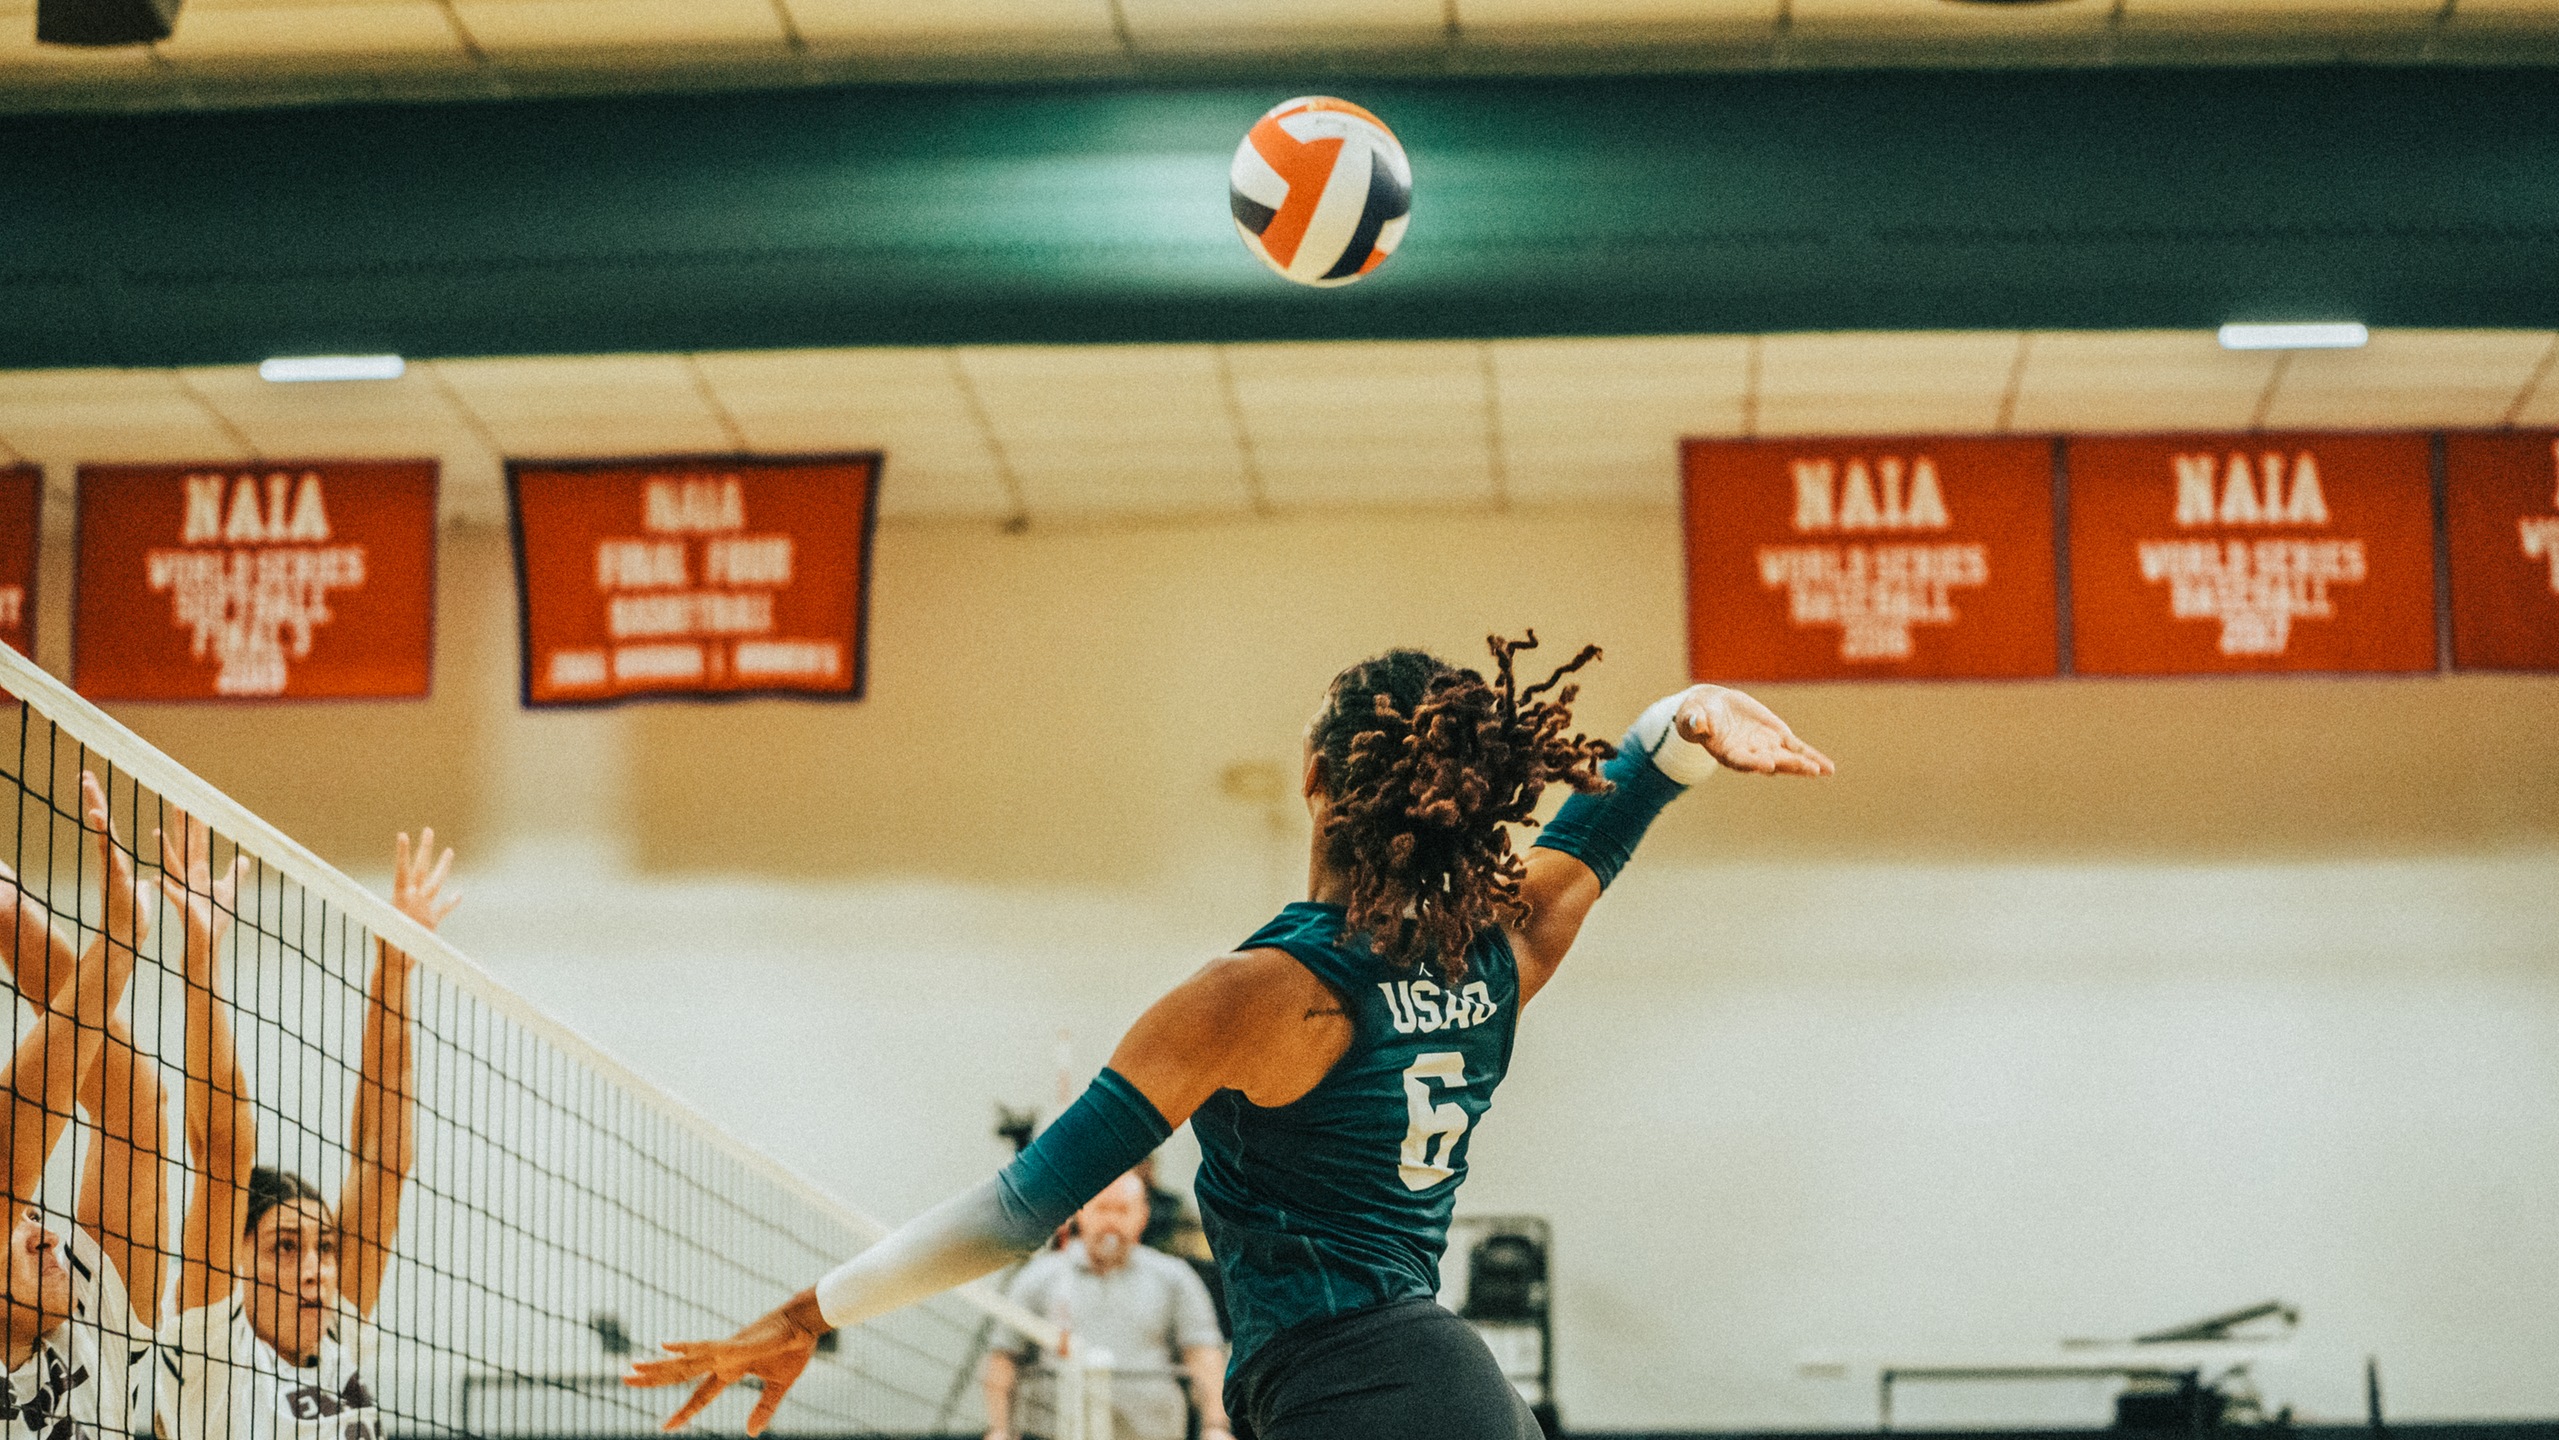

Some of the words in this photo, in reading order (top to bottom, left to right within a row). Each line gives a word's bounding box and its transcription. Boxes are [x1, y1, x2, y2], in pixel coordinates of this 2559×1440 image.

[184, 474, 330, 542] NAIA
[1792, 458, 1949, 530] NAIA
[2174, 451, 2330, 526] NAIA
[1398, 1051, 1468, 1192] 6
